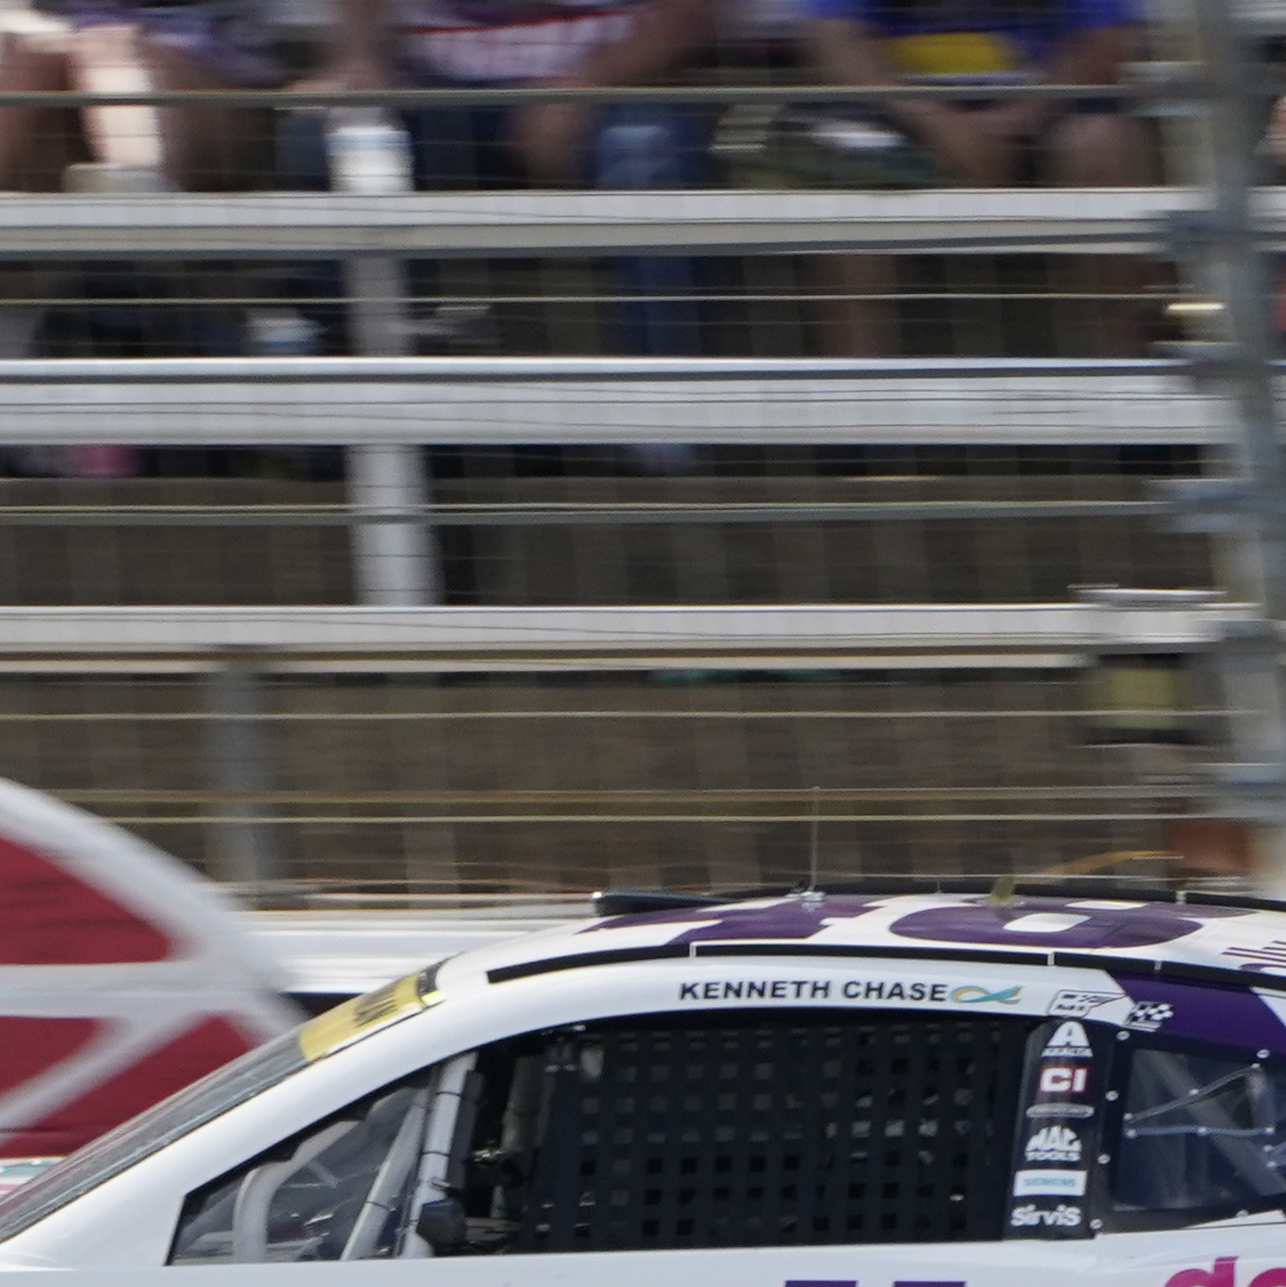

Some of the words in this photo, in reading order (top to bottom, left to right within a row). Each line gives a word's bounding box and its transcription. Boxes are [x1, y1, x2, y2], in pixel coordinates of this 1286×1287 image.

[679, 980, 832, 1000] KENNETH
[842, 980, 949, 1002] CHASE
[1039, 1066, 1088, 1093] CI
